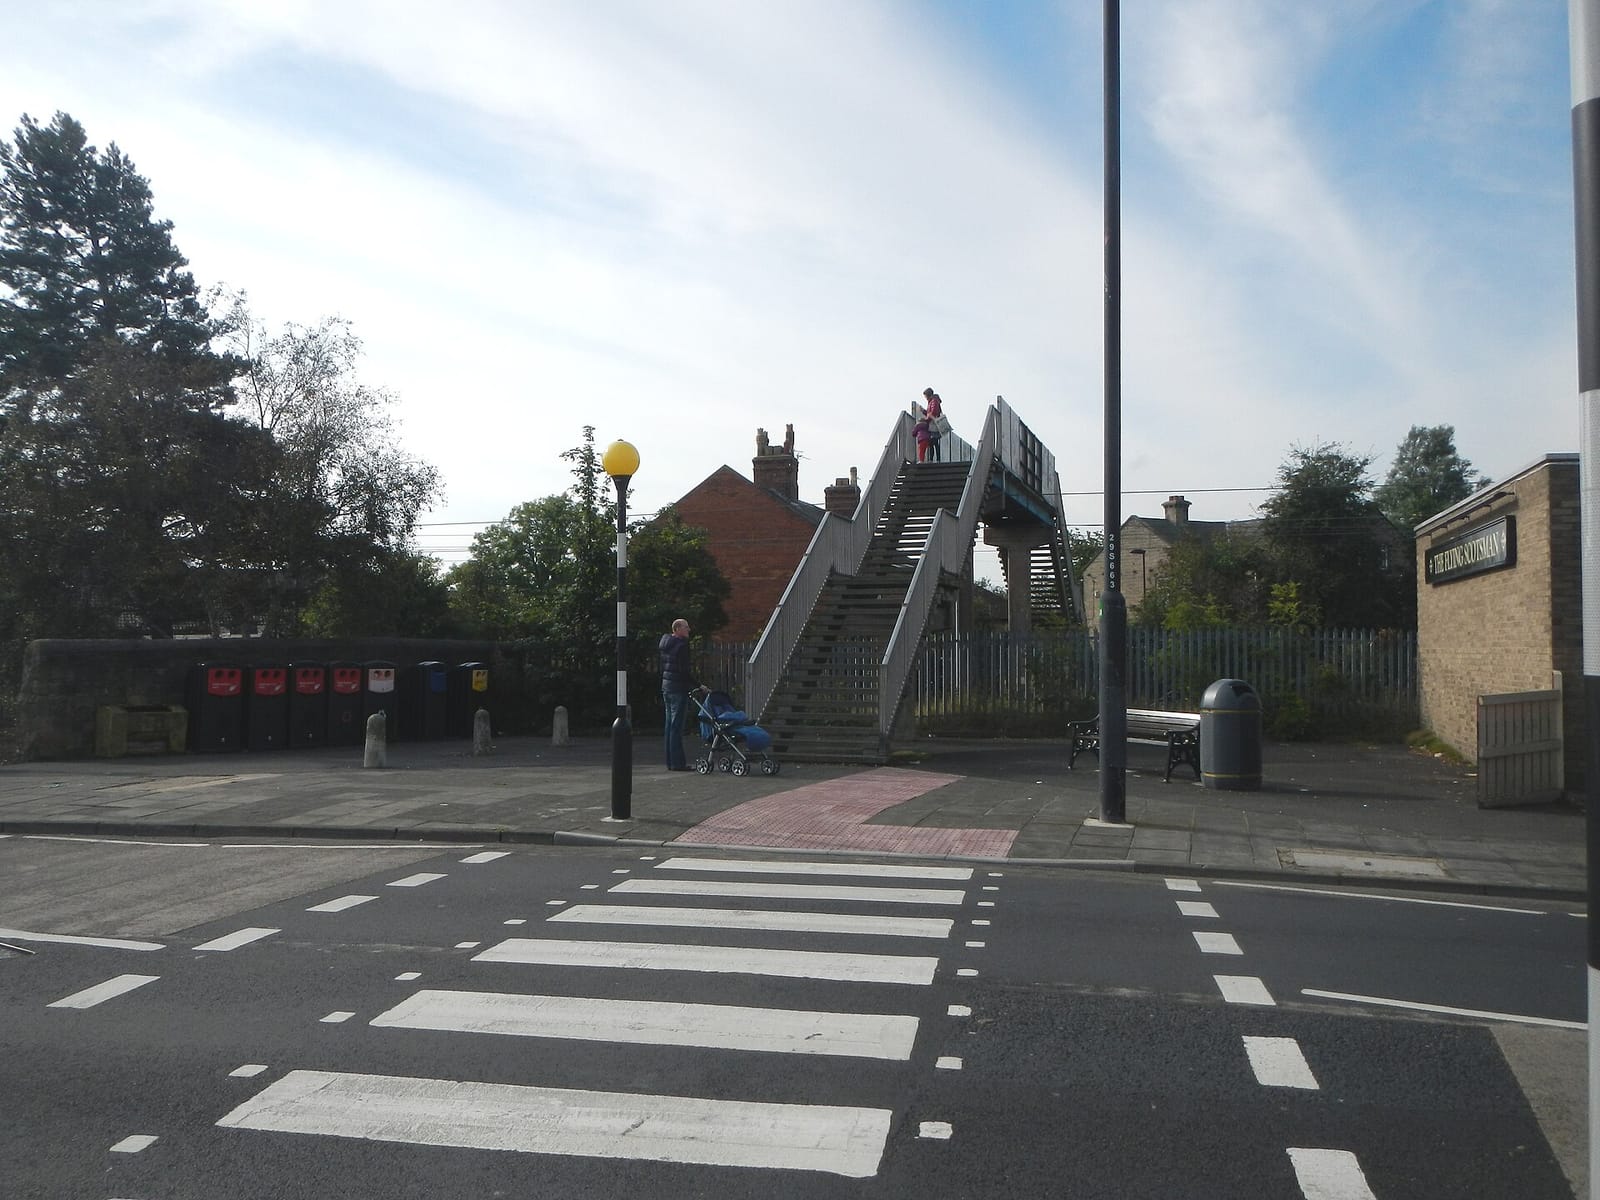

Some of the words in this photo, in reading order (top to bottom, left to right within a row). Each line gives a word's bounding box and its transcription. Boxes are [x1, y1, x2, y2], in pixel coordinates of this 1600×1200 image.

[1434, 553, 1444, 574] THE
[1444, 545, 1463, 571] FLYING
[1463, 532, 1499, 565] SCOTSMAN
